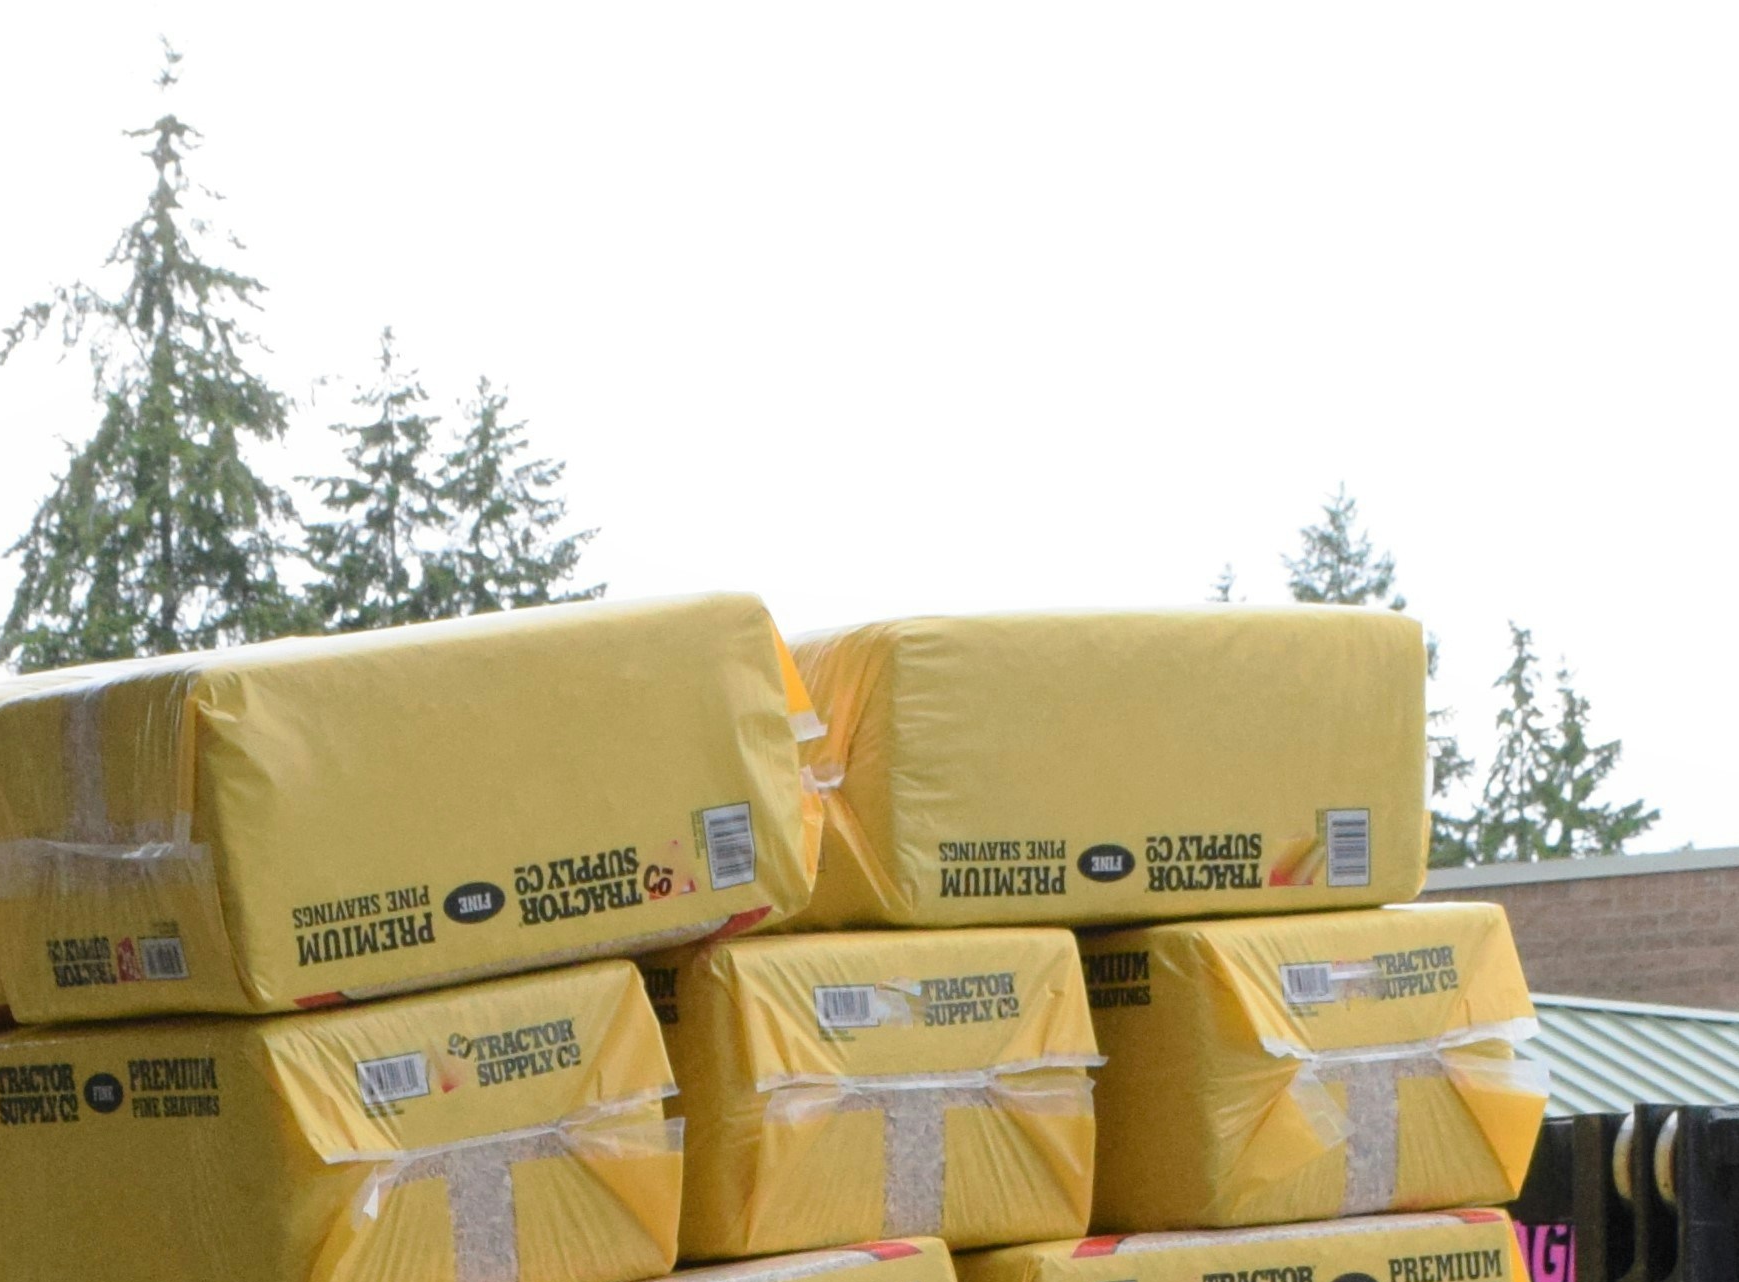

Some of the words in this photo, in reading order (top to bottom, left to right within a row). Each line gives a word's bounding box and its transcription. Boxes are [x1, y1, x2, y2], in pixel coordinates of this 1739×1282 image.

[939, 843, 1020, 861] SHAVINGS
[1026, 840, 1065, 860] PINE
[1179, 834, 1262, 860] SUPPLY
[548, 848, 638, 889] SUPPLY
[1091, 854, 1122, 872] FINE
[1146, 863, 1262, 892] TRACTOR
[940, 868, 1065, 897] PREMIUM
[293, 893, 382, 929] SHAVINGS
[387, 886, 430, 914] PINE
[459, 893, 491, 914] FINE
[519, 881, 642, 926] TRACTOR
[298, 913, 435, 965] PREMIUM
[1373, 945, 1453, 974] TRACTOR
[923, 972, 1014, 997] TRACTOR
[925, 999, 991, 1027] SUPPLY
[474, 1018, 574, 1060] TRACTOR
[128, 1057, 218, 1094] PREMIUM
[476, 1053, 552, 1087] SUPPLY
[132, 1096, 159, 1118] PINE
[162, 1092, 220, 1117] SHAVINGS
